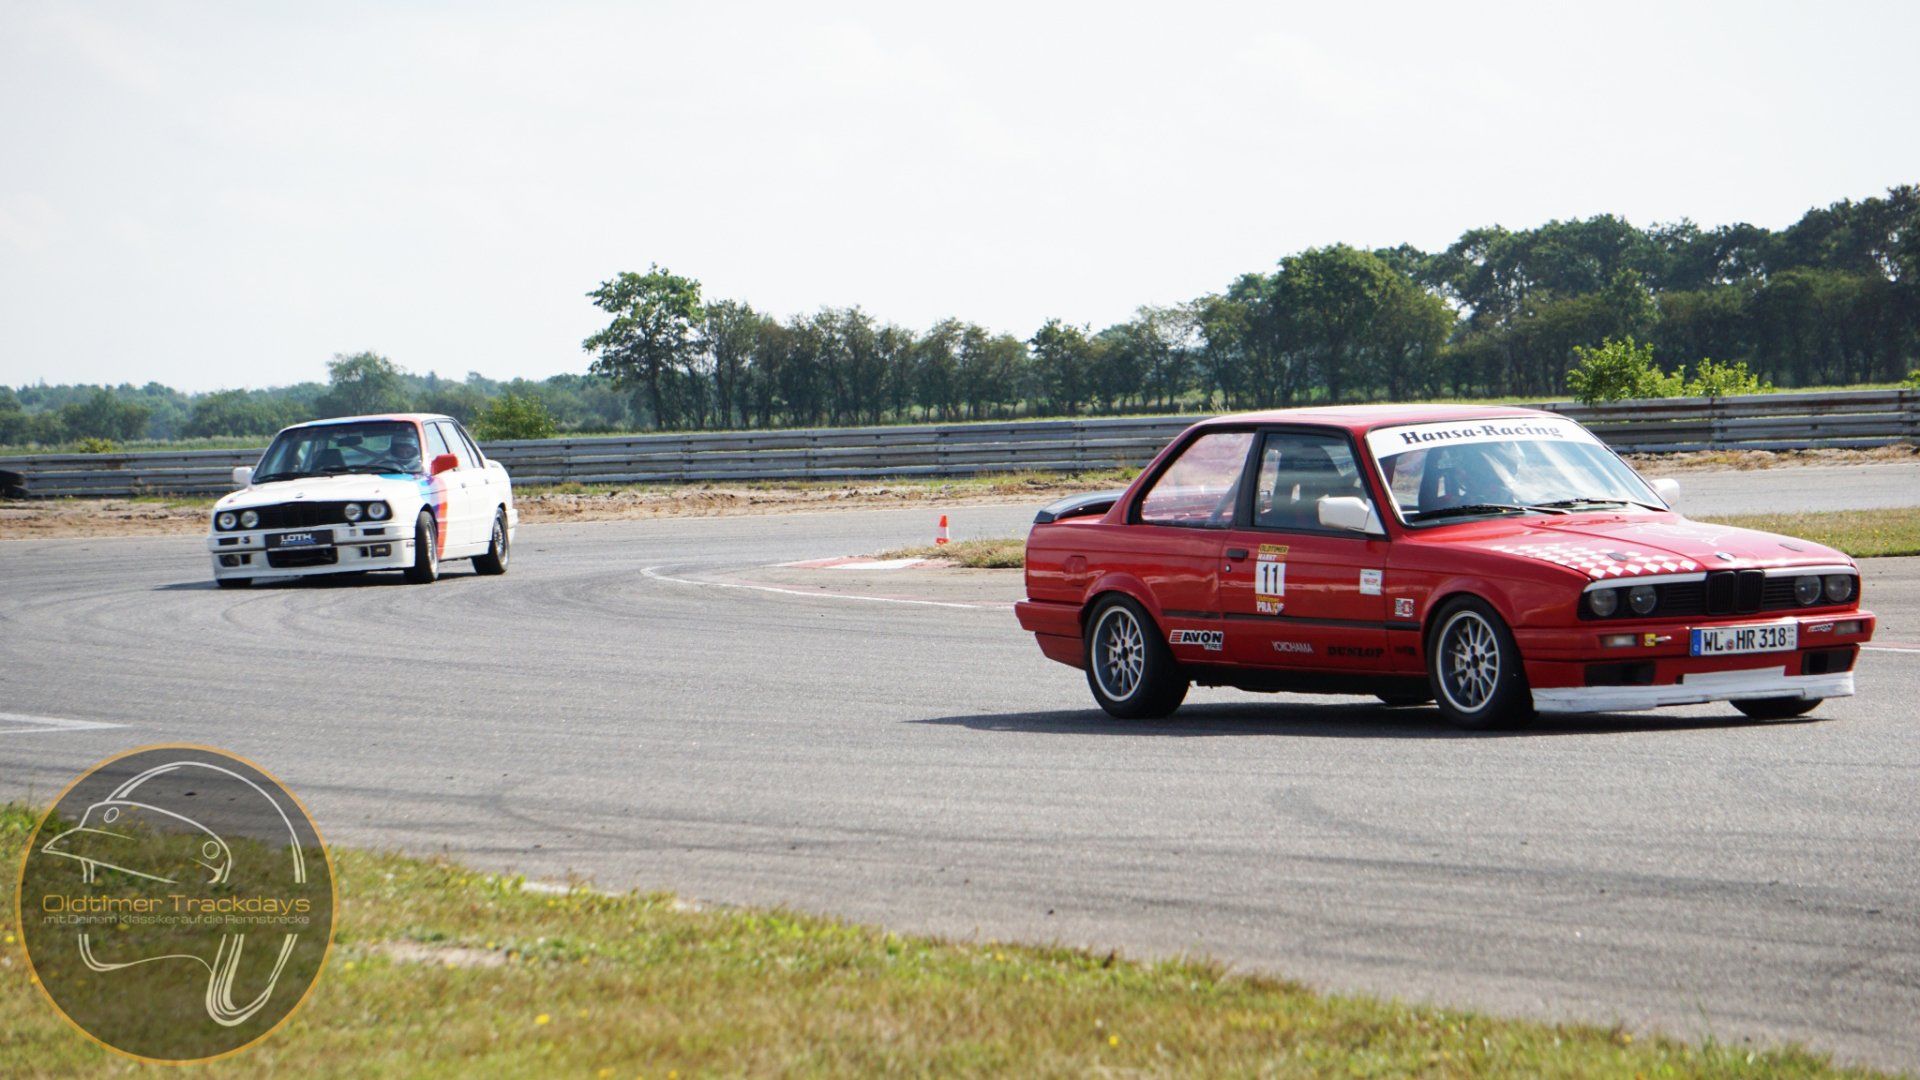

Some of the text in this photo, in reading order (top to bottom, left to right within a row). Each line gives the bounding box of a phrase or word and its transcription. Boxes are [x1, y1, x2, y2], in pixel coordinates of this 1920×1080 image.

[1400, 423, 1564, 445] Hansa-Racing
[1263, 563, 1278, 594] 11
[1182, 631, 1223, 643] AVON
[1703, 627, 1787, 652] WL HR 318
[1271, 640, 1314, 653] YOKOHAMA
[1327, 646, 1385, 658] DUNLOP
